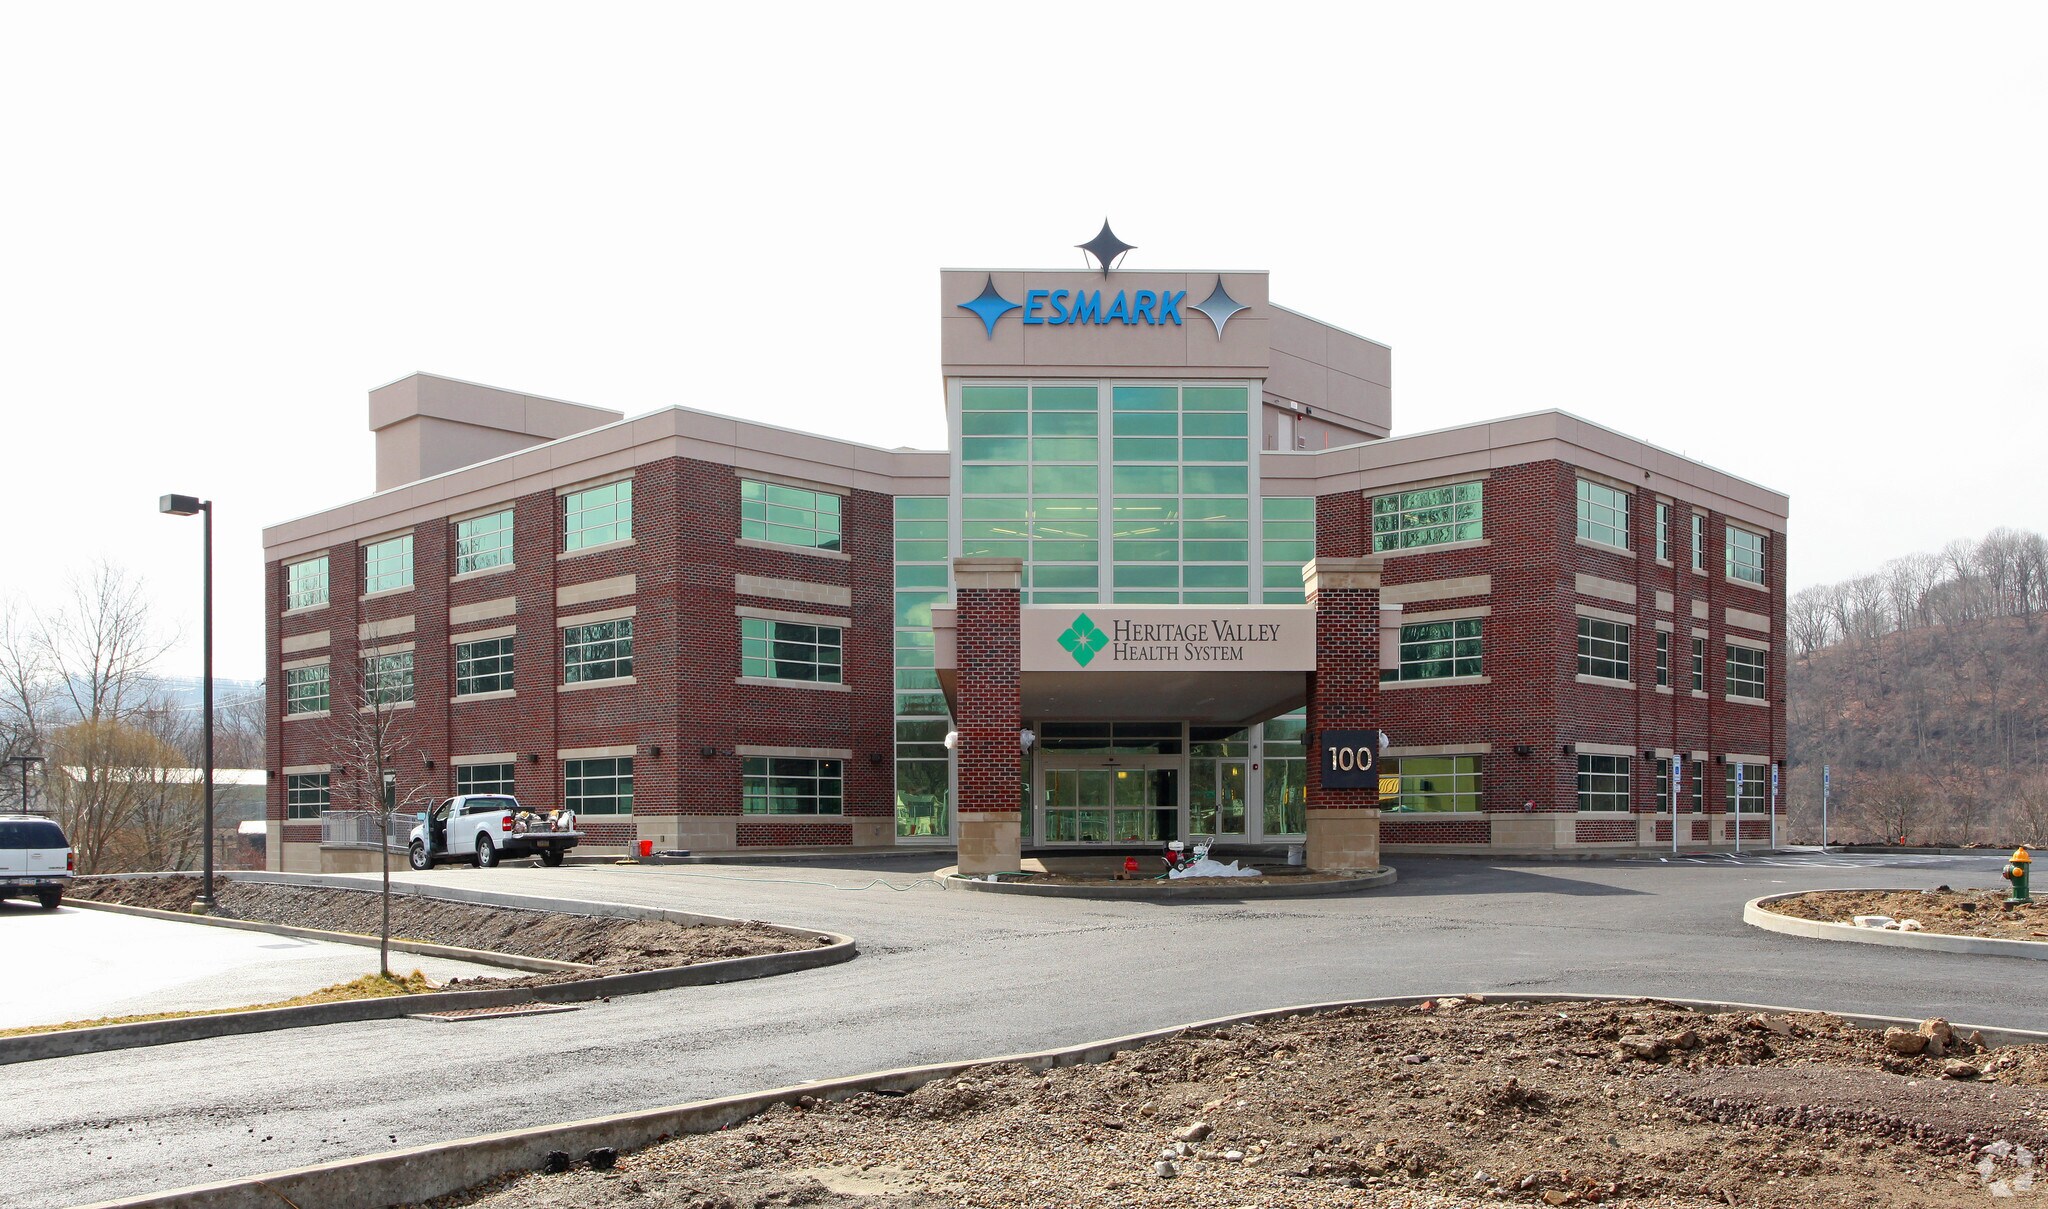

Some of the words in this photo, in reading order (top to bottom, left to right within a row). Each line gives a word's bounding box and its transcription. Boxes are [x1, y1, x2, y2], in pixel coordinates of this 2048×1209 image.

[1023, 289, 1187, 325] ESMARK
[1113, 620, 1208, 642] HERITAGE
[1211, 620, 1280, 642] VALLEY
[1113, 643, 1179, 661] HEALTH
[1184, 643, 1243, 661] SYSTEM
[1328, 747, 1373, 772] 100
